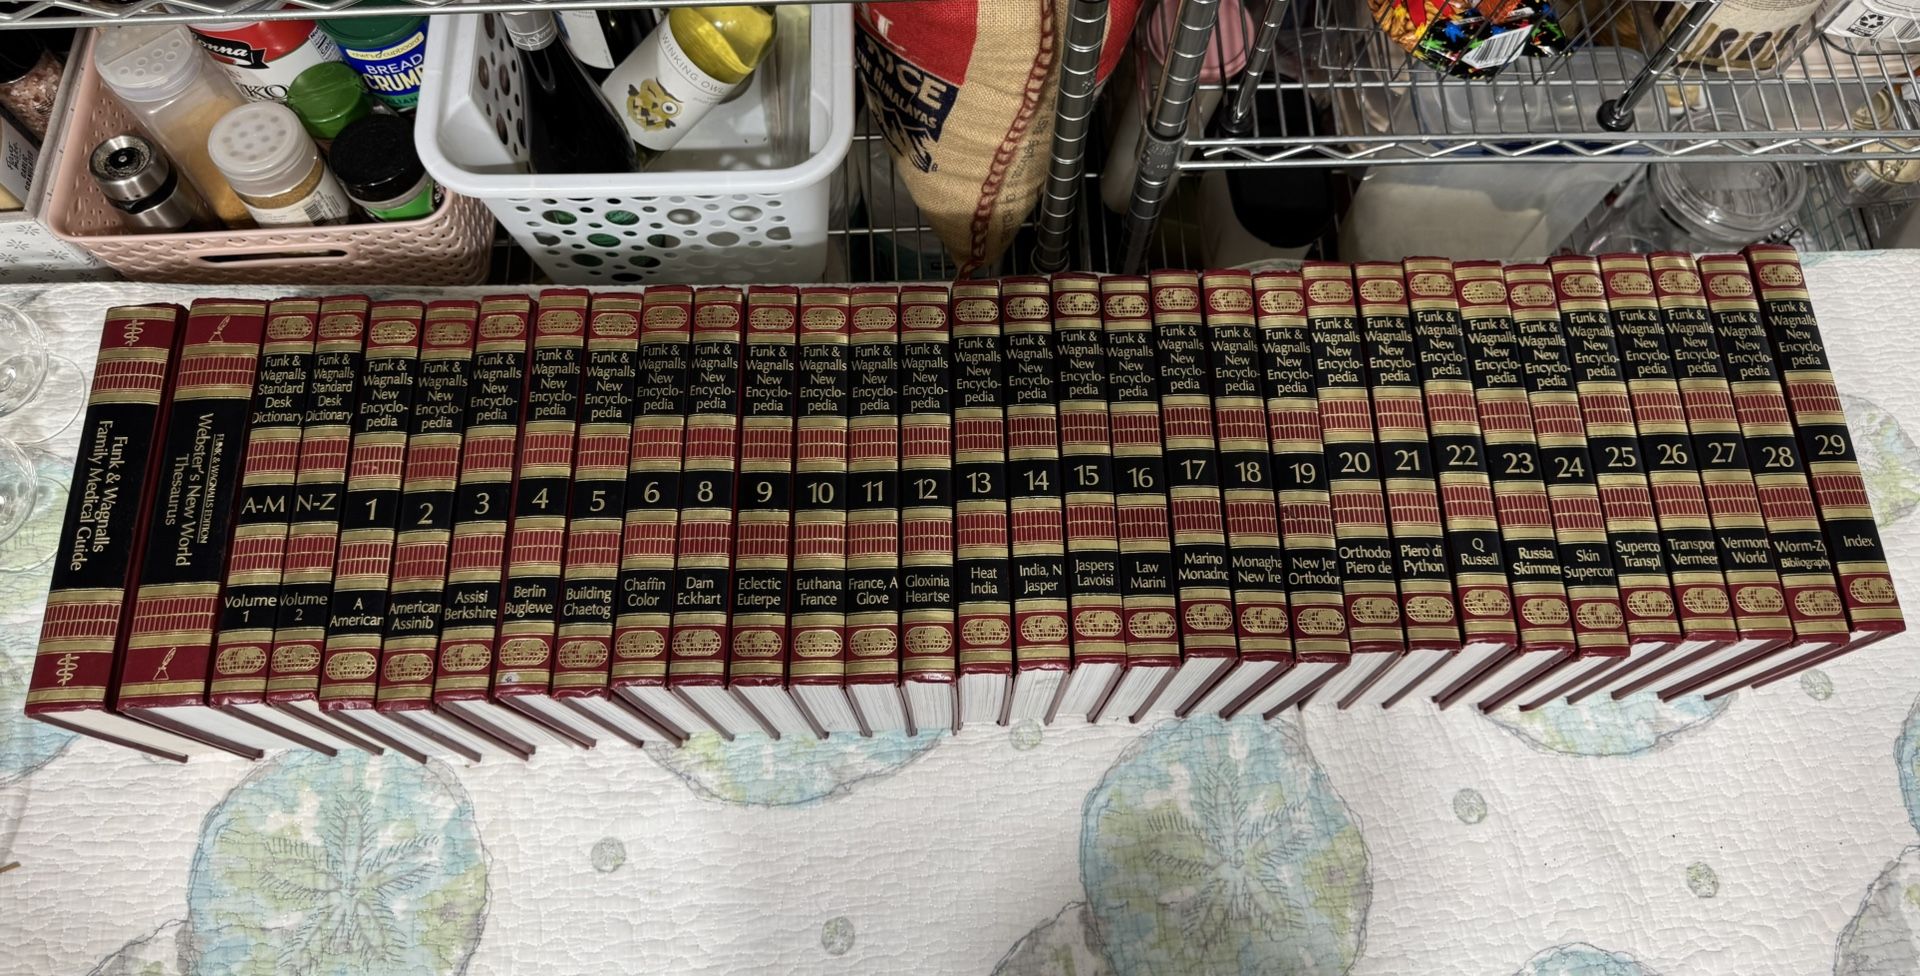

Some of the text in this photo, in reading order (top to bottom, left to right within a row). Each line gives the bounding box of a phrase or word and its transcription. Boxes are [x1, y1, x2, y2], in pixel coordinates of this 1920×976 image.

[365, 54, 423, 75] BREAD
[662, 33, 699, 81] WINKING
[873, 66, 938, 129] HIMALAYAS
[1770, 302, 1808, 313] Funk &
[1367, 317, 1405, 329] Funk &
[1768, 315, 1818, 328] Wagnalls
[1364, 331, 1413, 344] Wagnalls
[1786, 329, 1811, 340] New
[803, 345, 841, 358] Funk &
[1378, 345, 1405, 356] New
[1779, 341, 1824, 355] Encyclo-
[265, 354, 301, 368] Funk &
[318, 353, 350, 366] Funk &
[799, 359, 847, 374] Wagnalls
[1369, 357, 1416, 371] Encyclo-
[1791, 355, 1821, 369] pedia
[260, 368, 307, 384] Wagnalls
[313, 367, 355, 382] Wagnalls
[810, 374, 836, 385] New
[1380, 371, 1411, 386] pedia
[258, 382, 304, 396] Standard
[311, 381, 353, 394] Standard
[800, 386, 846, 400] Encyclo-
[265, 396, 292, 409] Desk
[317, 394, 342, 407] Desk
[807, 399, 838, 414] pedia
[305, 409, 353, 424] Dictionary
[215, 433, 225, 456] FUNK
[1815, 434, 1846, 456] 29
[1394, 450, 1421, 471] 21
[1446, 444, 1479, 466] 22
[1605, 446, 1637, 468] 25
[1657, 443, 1688, 465] 26
[1708, 442, 1736, 464] 27
[1762, 446, 1795, 468] 28
[1180, 459, 1207, 480] 17
[1339, 452, 1371, 473] 20
[1503, 452, 1535, 474] 23
[1555, 456, 1585, 478] 24
[1073, 464, 1100, 486] 15
[1127, 467, 1154, 488] 16
[1235, 461, 1262, 483] 18
[1289, 462, 1316, 484] 19
[206, 465, 220, 509] WAGNALLS
[966, 472, 992, 493] 13
[1024, 470, 1050, 491] 14
[70, 420, 114, 572] Family Medical Guide
[92, 435, 129, 553] Funk & Wagnalls
[165, 454, 190, 526] Thesaurus
[175, 413, 215, 567] Webster's New World
[644, 481, 661, 503] 6
[697, 480, 714, 502] 8
[757, 481, 773, 503] 9
[807, 482, 834, 504] 10
[862, 480, 884, 502] 11
[913, 478, 938, 500] 12
[241, 495, 285, 515] A-M
[296, 493, 336, 512] N-Z
[474, 492, 490, 515] 3
[532, 487, 549, 509] 4
[589, 490, 606, 512] 5
[365, 498, 377, 520] 1
[417, 503, 434, 525] 2
[200, 509, 213, 544] EDITION
[1471, 537, 1485, 552] Q
[1721, 537, 1770, 549] Vermont
[1843, 535, 1875, 547] Index
[1184, 552, 1223, 565] Marino
[1400, 544, 1443, 558] Piero di
[1518, 547, 1554, 560] Russia
[1575, 550, 1600, 563] Skin
[1732, 551, 1768, 564] World
[1074, 559, 1115, 574] Jaspers
[1136, 561, 1159, 573] Law
[1292, 557, 1337, 571] New Jer
[1345, 560, 1392, 574] Piero de
[1460, 553, 1499, 566] Russell
[1621, 555, 1661, 570] Transpl
[1671, 554, 1718, 566] Vermeer
[971, 567, 998, 579] Heat
[1019, 563, 1063, 577] India, N
[1403, 560, 1445, 576] Python
[624, 577, 666, 591] Chaffin
[686, 577, 714, 589] Dam
[738, 576, 782, 590] Eclectic
[796, 576, 842, 590] Euthana
[848, 577, 899, 591] France, A
[905, 574, 950, 588] Gloxinia
[1077, 574, 1114, 586] Lavoisi
[1130, 576, 1166, 589] Marini
[1238, 571, 1282, 583] New Ire
[513, 584, 547, 598] Berlin
[566, 585, 613, 603] Building
[971, 582, 998, 595] India
[1024, 580, 1058, 595] Jasper
[224, 594, 277, 608] Volume
[279, 592, 328, 607] Volume
[353, 597, 364, 610] A
[454, 590, 488, 604] Assisi
[627, 593, 660, 606] Color
[677, 591, 722, 605] Eckhart
[737, 593, 781, 609] Euterpe
[800, 594, 837, 606] France
[856, 592, 889, 605] Glove
[905, 590, 950, 603] Heartse
[243, 610, 250, 623] 1
[294, 608, 303, 621] 2
[444, 605, 497, 621] Berkshire
[504, 600, 553, 618] Buglewe
[563, 603, 611, 619] Chaetog
[391, 616, 434, 630] Assinib
